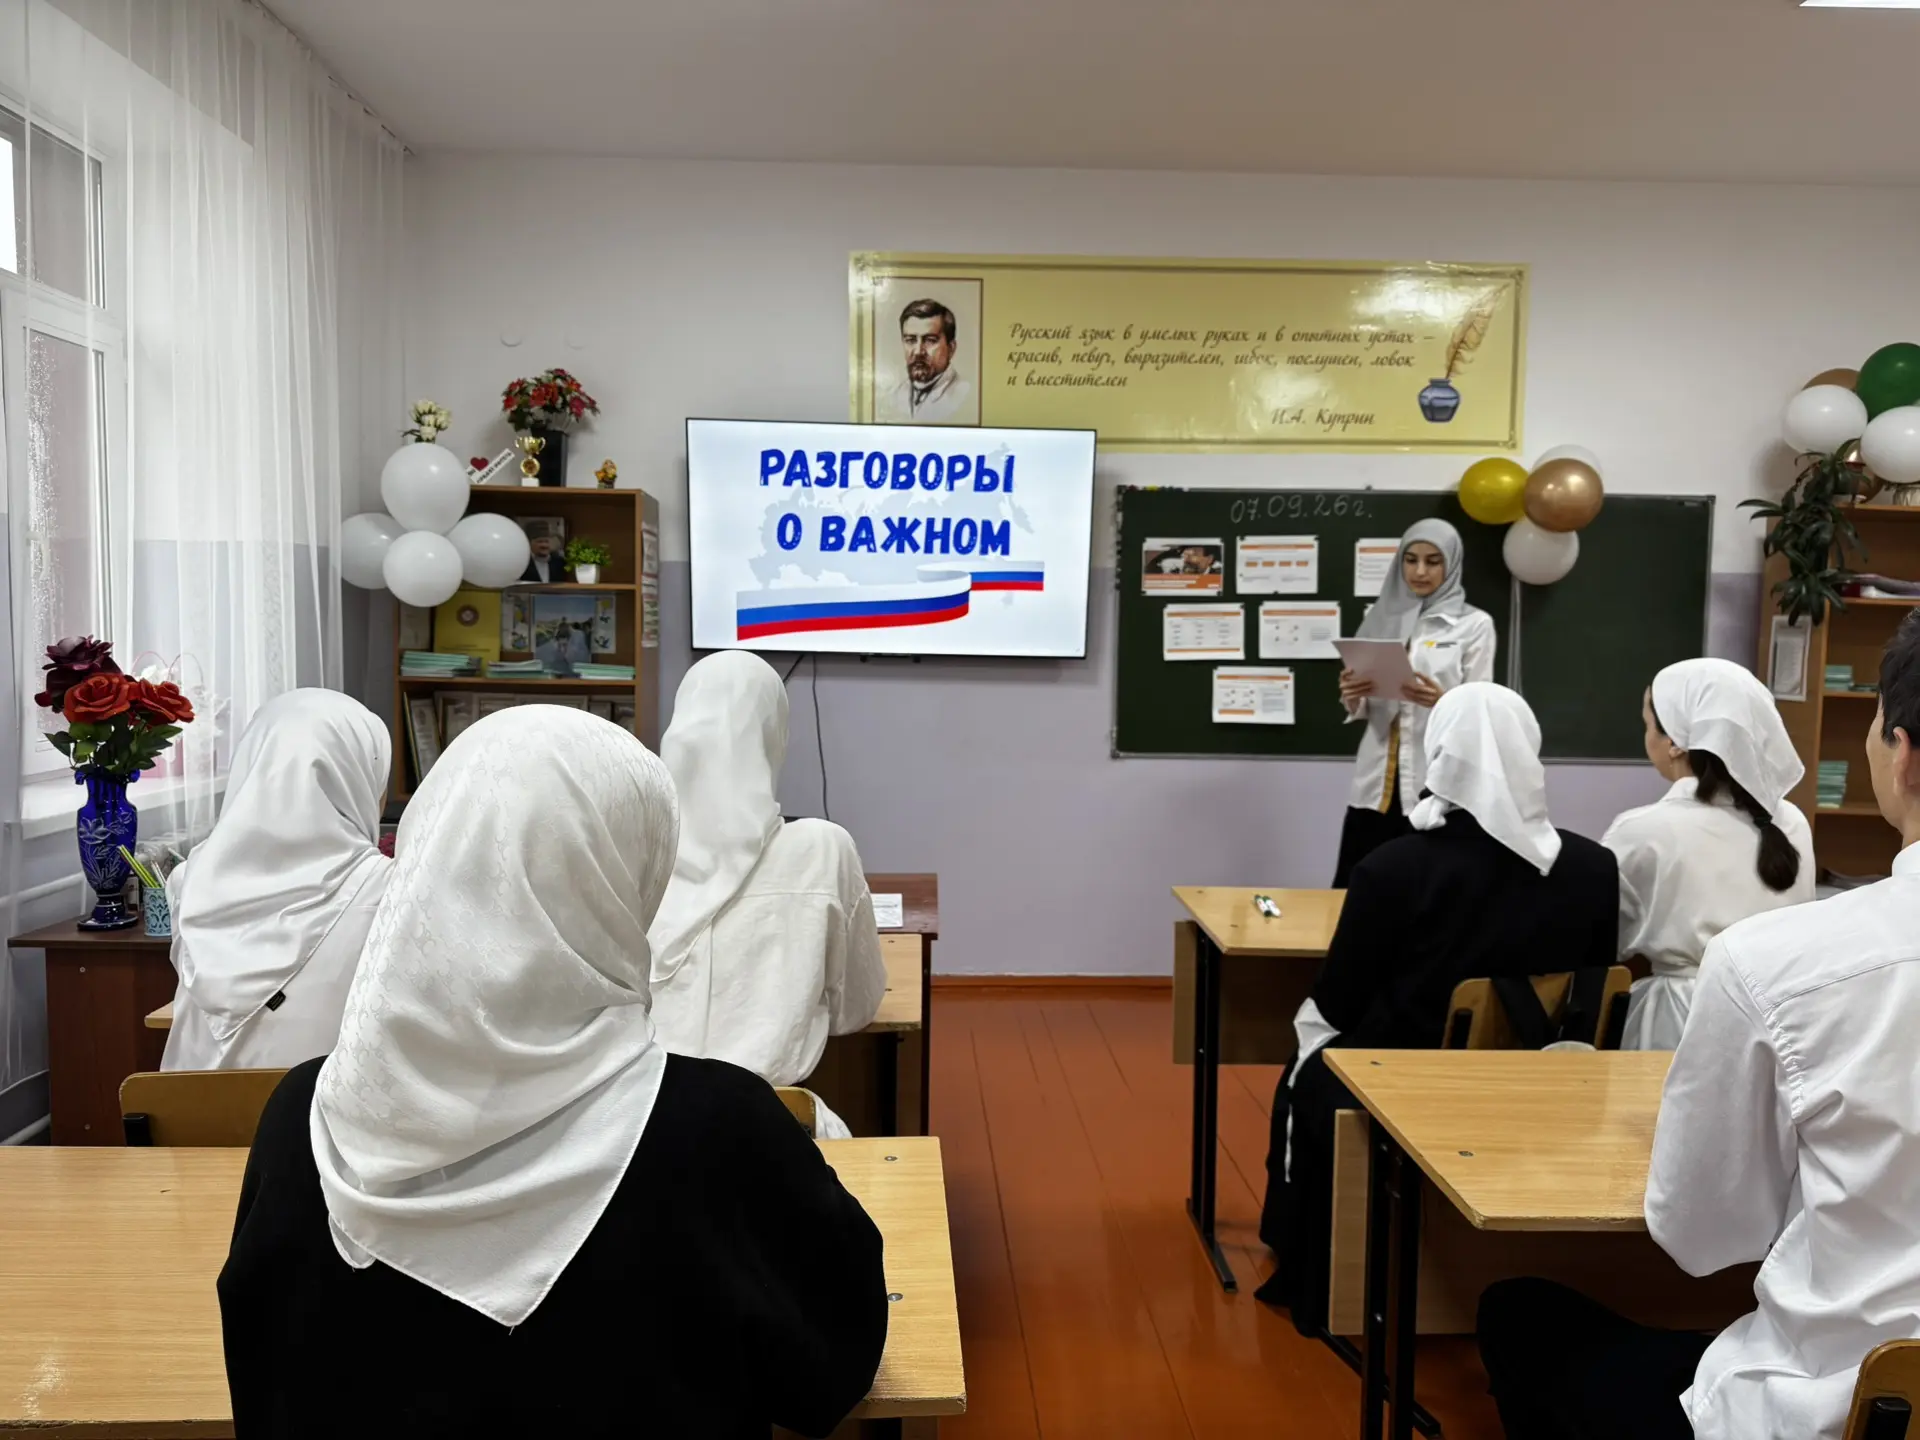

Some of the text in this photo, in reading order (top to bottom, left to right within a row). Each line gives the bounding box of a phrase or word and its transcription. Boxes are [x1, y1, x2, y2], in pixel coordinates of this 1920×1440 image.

[1010, 323, 1072, 346] Русский
[1078, 327, 1115, 346] язык
[1123, 324, 1134, 341] в
[1138, 328, 1197, 348] умелых
[1203, 329, 1249, 348] руках
[1256, 329, 1267, 342] и
[1275, 325, 1286, 342] в
[1291, 329, 1360, 343] опытных
[1364, 329, 1415, 350] устах
[1007, 346, 1062, 369] красив,
[1071, 349, 1115, 371] певуч,
[1124, 347, 1224, 371] выразителен,
[1286, 354, 1362, 373] послушен,
[1369, 350, 1415, 367] ловок
[1007, 369, 1128, 387] и вместителен
[1272, 408, 1375, 432] И.А. Куприн
[760, 449, 1015, 493] РАЗГОВОРЫ
[777, 513, 1010, 556] О ВАЖНОМ
